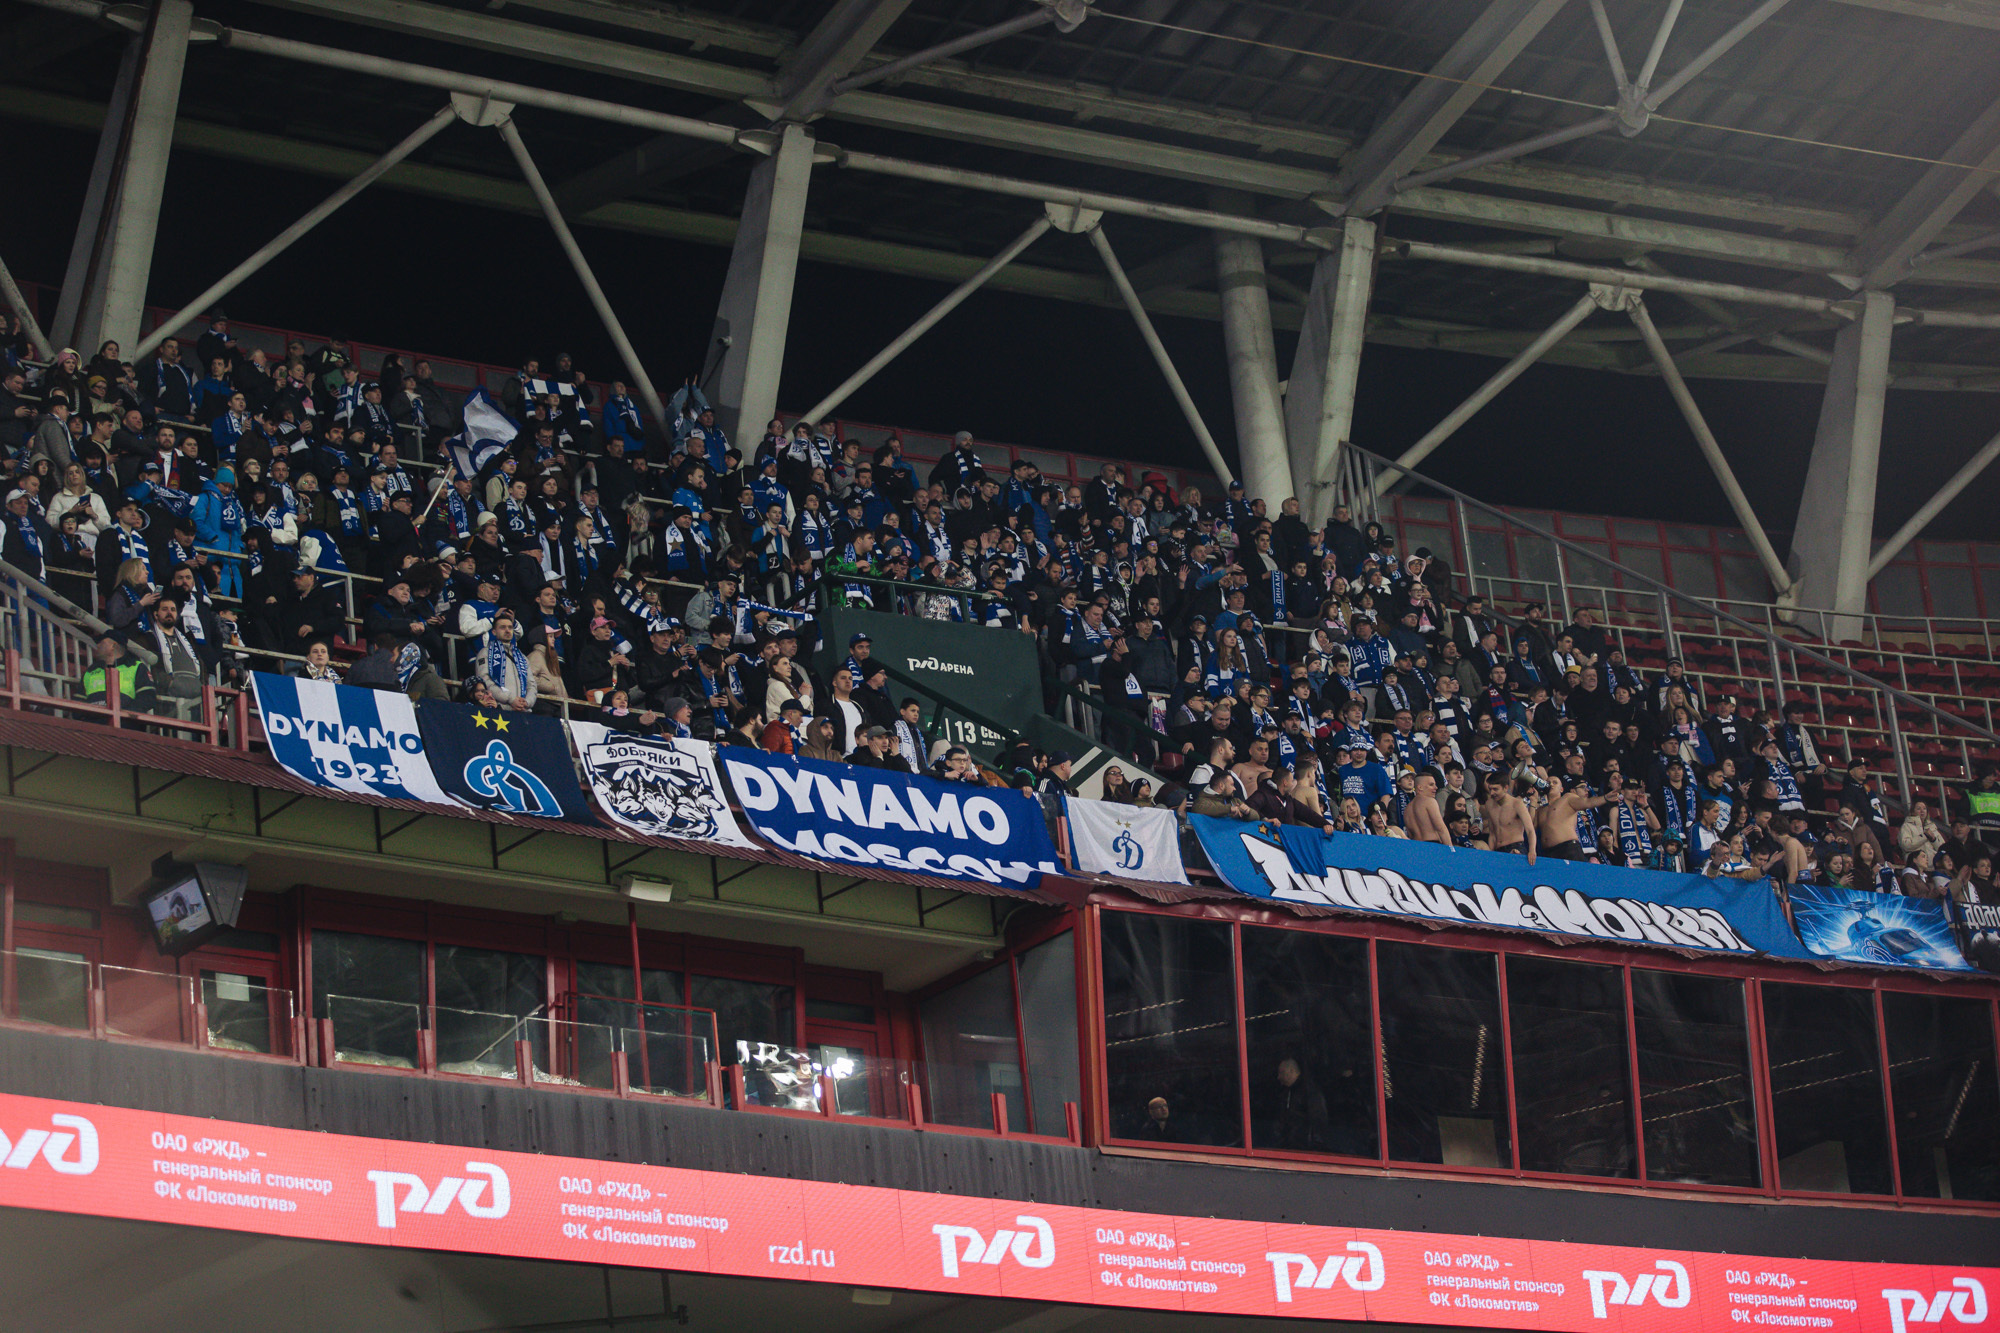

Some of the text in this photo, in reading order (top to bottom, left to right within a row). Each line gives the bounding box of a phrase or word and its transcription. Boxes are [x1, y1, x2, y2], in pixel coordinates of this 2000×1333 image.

[940, 664, 974, 676] АРЕНА
[269, 711, 423, 756] DYNAMO
[954, 720, 977, 744] 13
[606, 746, 681, 767] ДОБРЯКИ
[311, 755, 402, 786] 1923
[725, 759, 1011, 846] DYNAMO
[151, 1131, 188, 1153] ОАО
[192, 1137, 251, 1162] «РЖД»
[153, 1159, 334, 1197] генеральный спонсор
[559, 1175, 592, 1196] ОАО
[597, 1181, 652, 1203] «РЖД»
[154, 1179, 298, 1213] ФК «Локомотив»
[561, 1202, 729, 1234] генеральный спонсор
[562, 1221, 696, 1249] ФК «Локомотив»
[1095, 1228, 1125, 1246] ОАО
[1129, 1232, 1176, 1252] «РЖД»
[768, 1240, 836, 1268] rzd.ru
[1099, 1253, 1247, 1278] генеральный спонсор
[1423, 1250, 1451, 1267] ОАО
[1455, 1254, 1500, 1272] «РЖД»
[1101, 1270, 1218, 1294] ФК «Локомотив»
[1426, 1274, 1565, 1297] генеральный спонсор
[1725, 1270, 1751, 1285] ОАО
[1755, 1273, 1796, 1289] «РЖД»
[1429, 1291, 1540, 1312] ФК «Локомотив»
[1728, 1292, 1857, 1312] генеральный спонсор
[1731, 1308, 1833, 1328] ФК «Локомотив»
